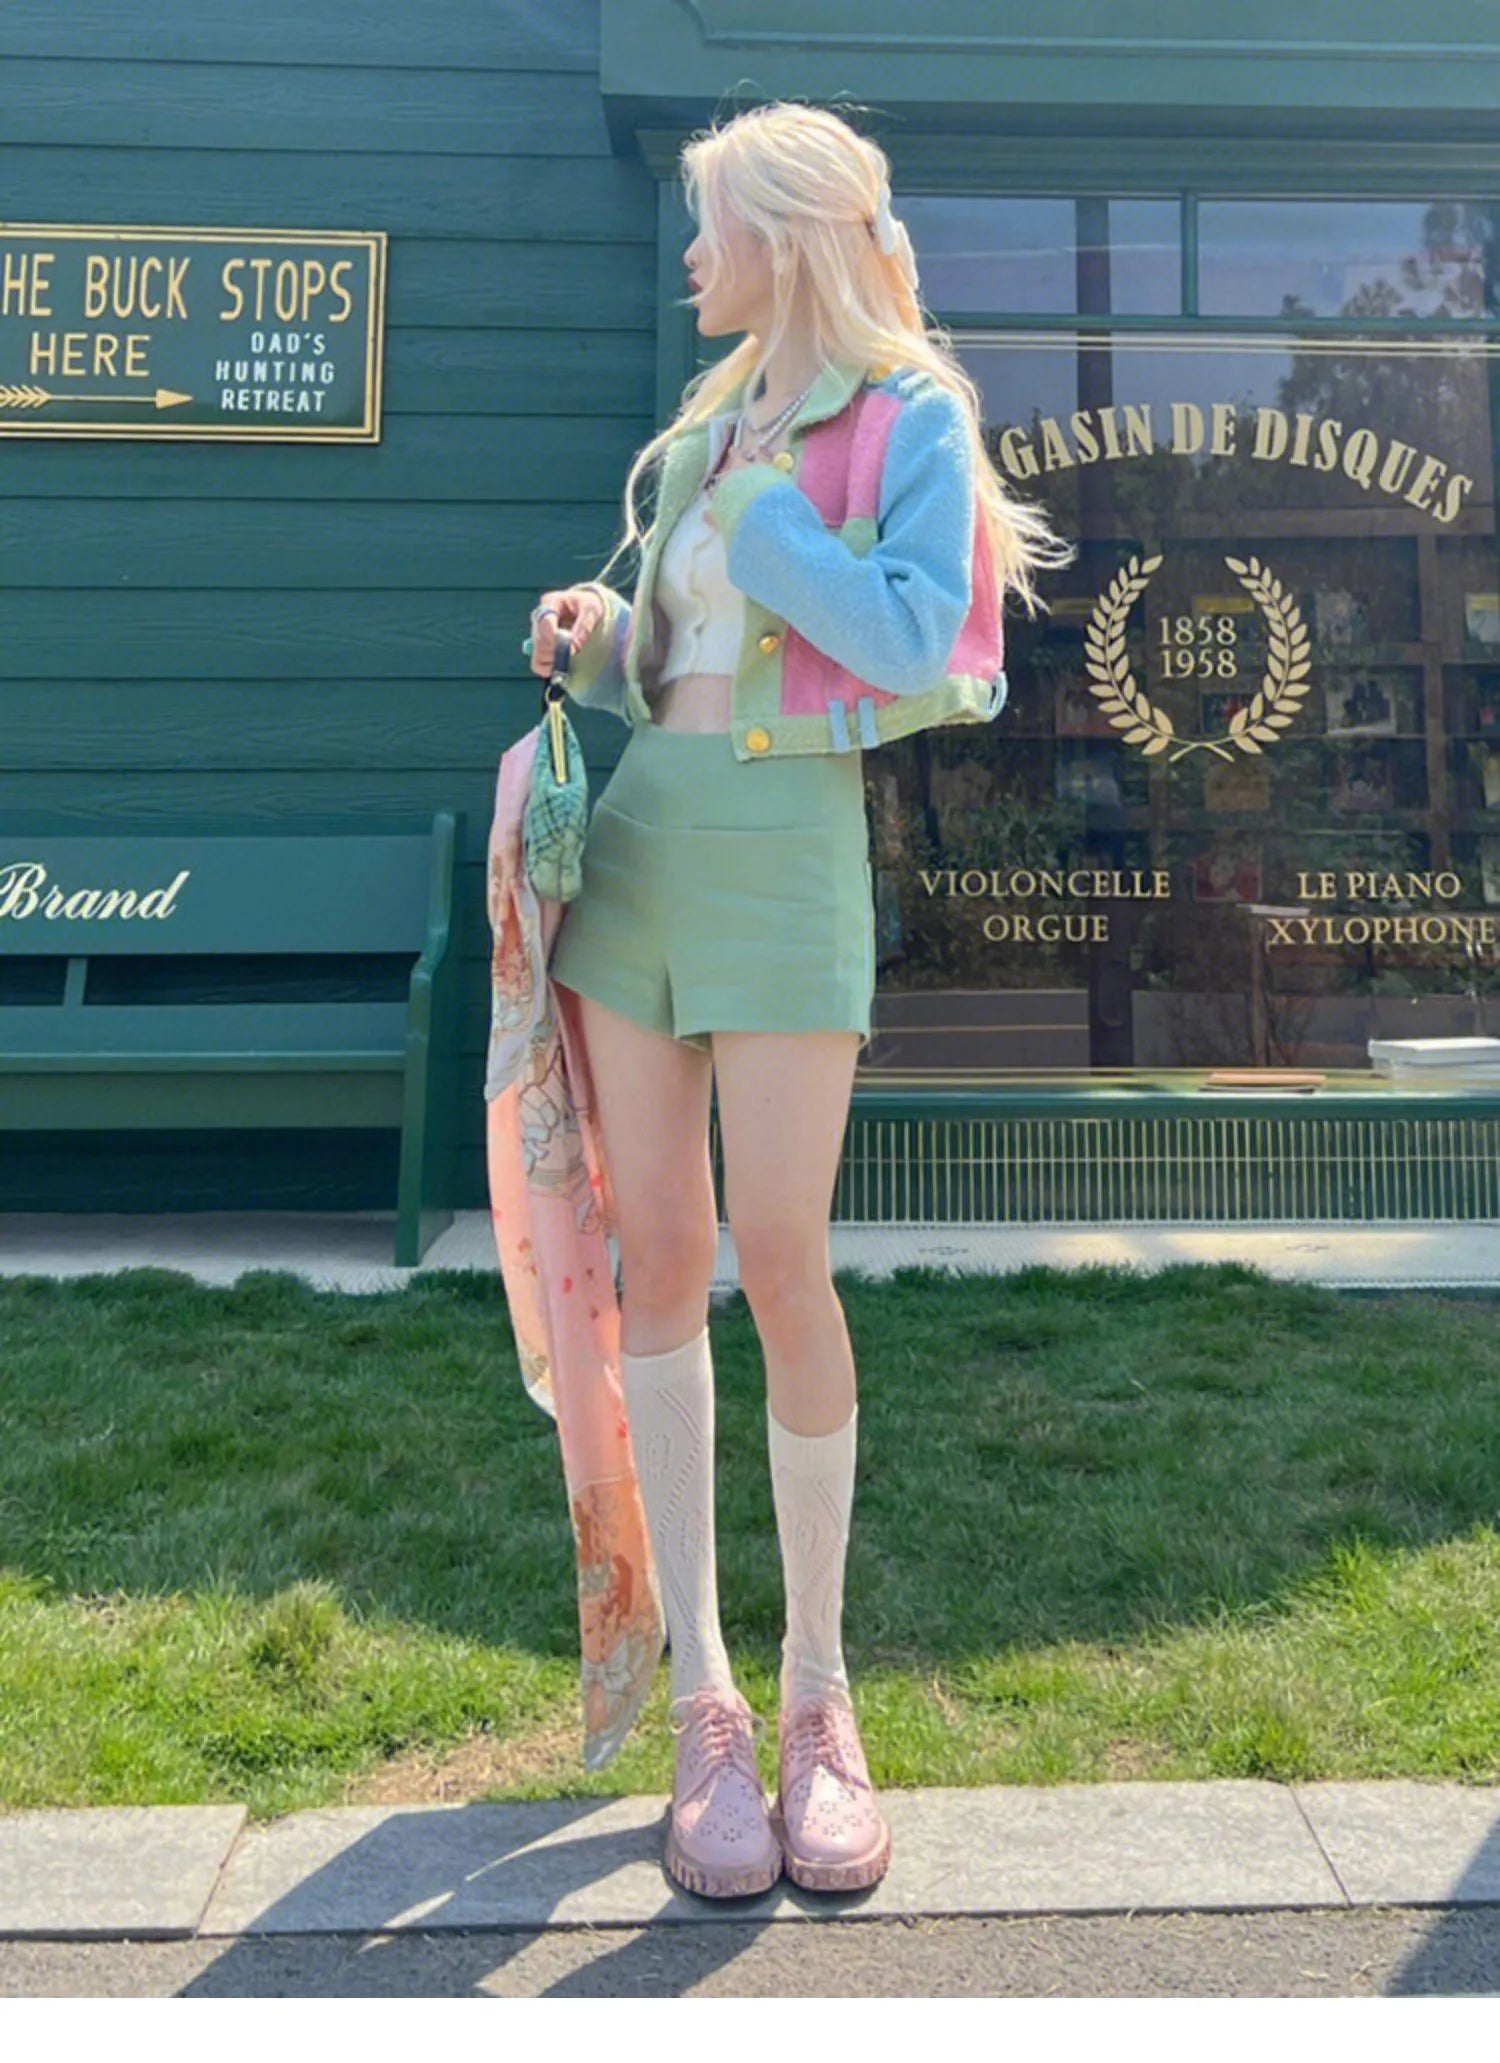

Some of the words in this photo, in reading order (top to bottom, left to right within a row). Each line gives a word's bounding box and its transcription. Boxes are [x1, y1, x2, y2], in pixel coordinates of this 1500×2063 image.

[85, 255, 191, 320] BUCK
[220, 258, 353, 322] STOPS
[30, 331, 151, 377] HERE
[251, 332, 326, 355] DAD'S
[215, 360, 335, 384] HUNTING
[221, 389, 326, 412] RETREAT
[1000, 403, 1155, 480] GASIN
[1171, 403, 1237, 456] DE
[1252, 408, 1474, 523] DISQUES
[1159, 616, 1237, 646] 1858
[1160, 649, 1237, 679] 1958
[0, 862, 191, 920] Brand
[918, 870, 1171, 897] VIOLONCELLE
[1297, 872, 1336, 899] LE
[1345, 872, 1461, 899] PIANO
[983, 915, 1109, 942] ORGUE
[1268, 917, 1496, 945] XYLOPHONE
